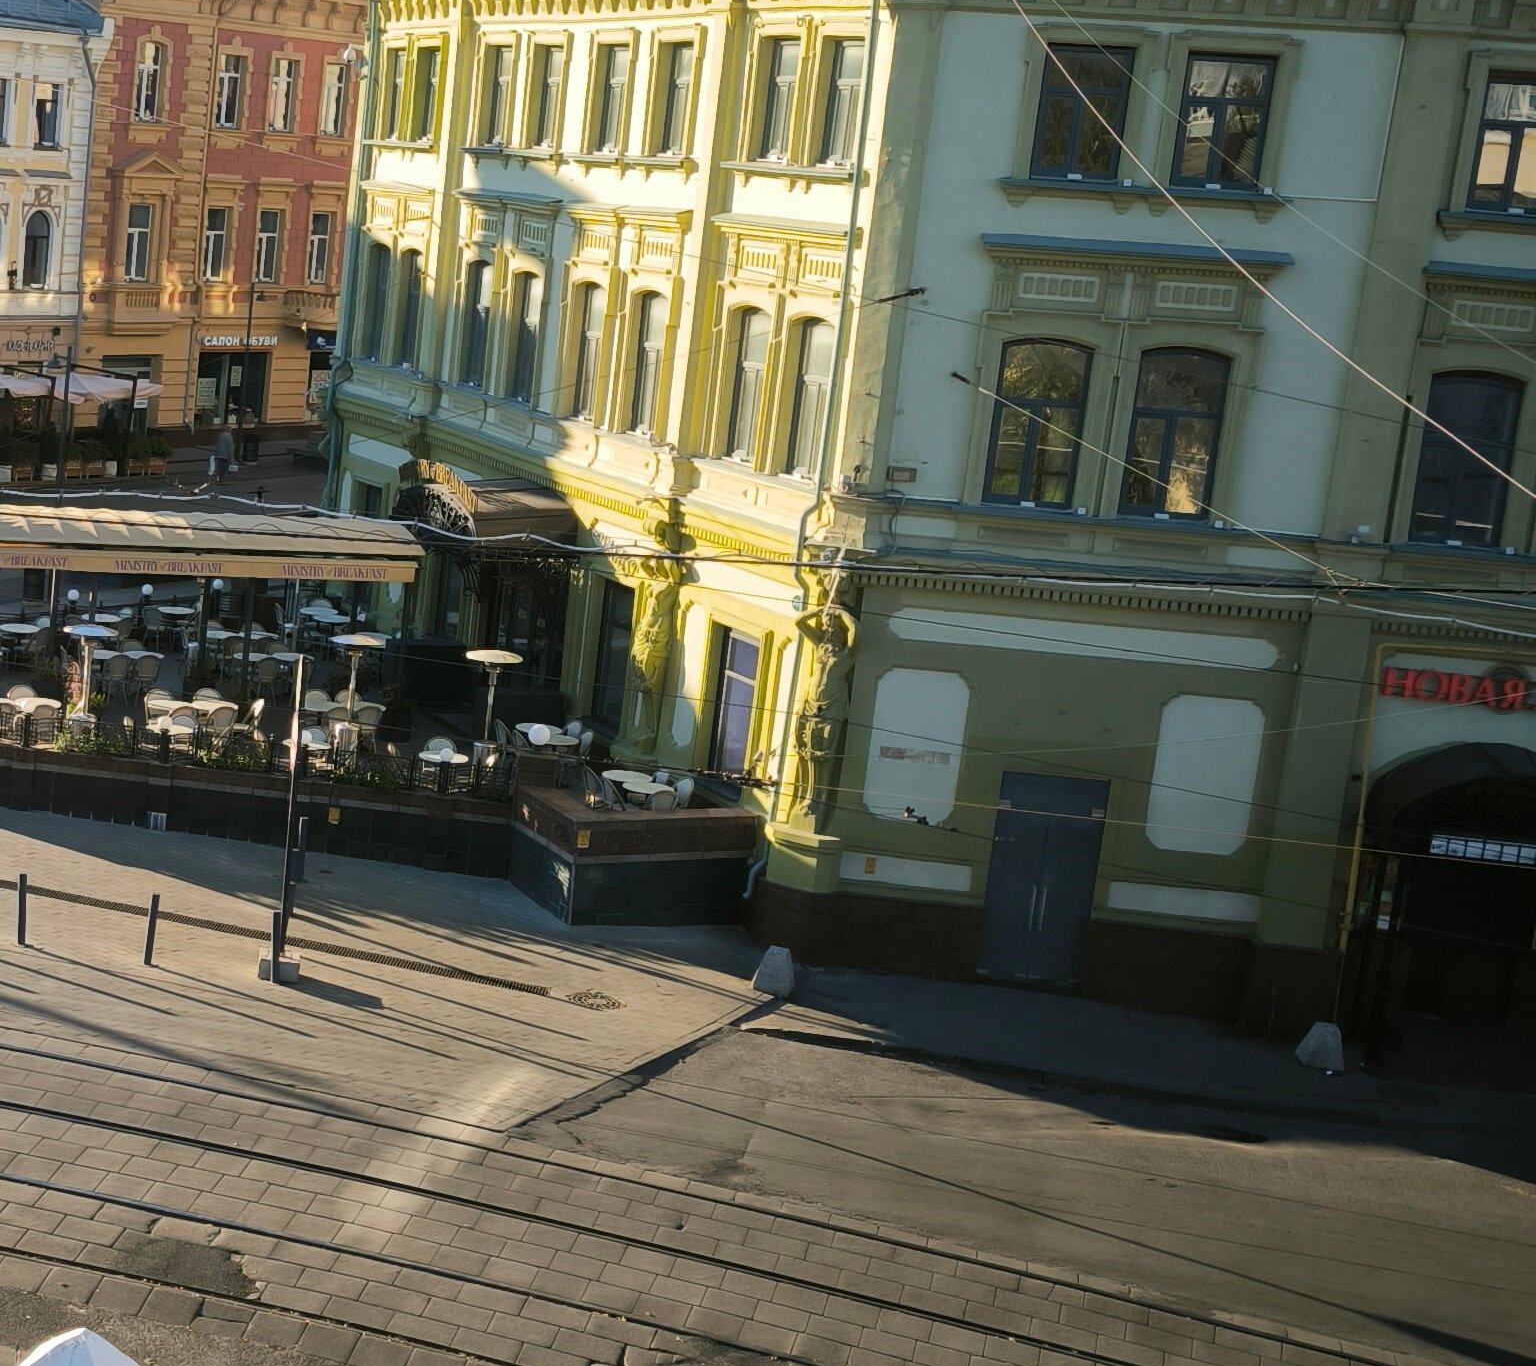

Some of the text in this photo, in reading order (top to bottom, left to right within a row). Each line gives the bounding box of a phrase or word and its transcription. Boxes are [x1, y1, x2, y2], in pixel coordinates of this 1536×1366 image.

[204, 336, 240, 346] САЛОН
[11, 554, 69, 567] BREAKFAST
[115, 559, 160, 572] MINISTRY
[168, 560, 224, 573] BREAKFAST
[282, 564, 324, 576] MINISTRY
[333, 567, 388, 579] BREAKFAST
[1382, 666, 1526, 711] НОВАЯ
